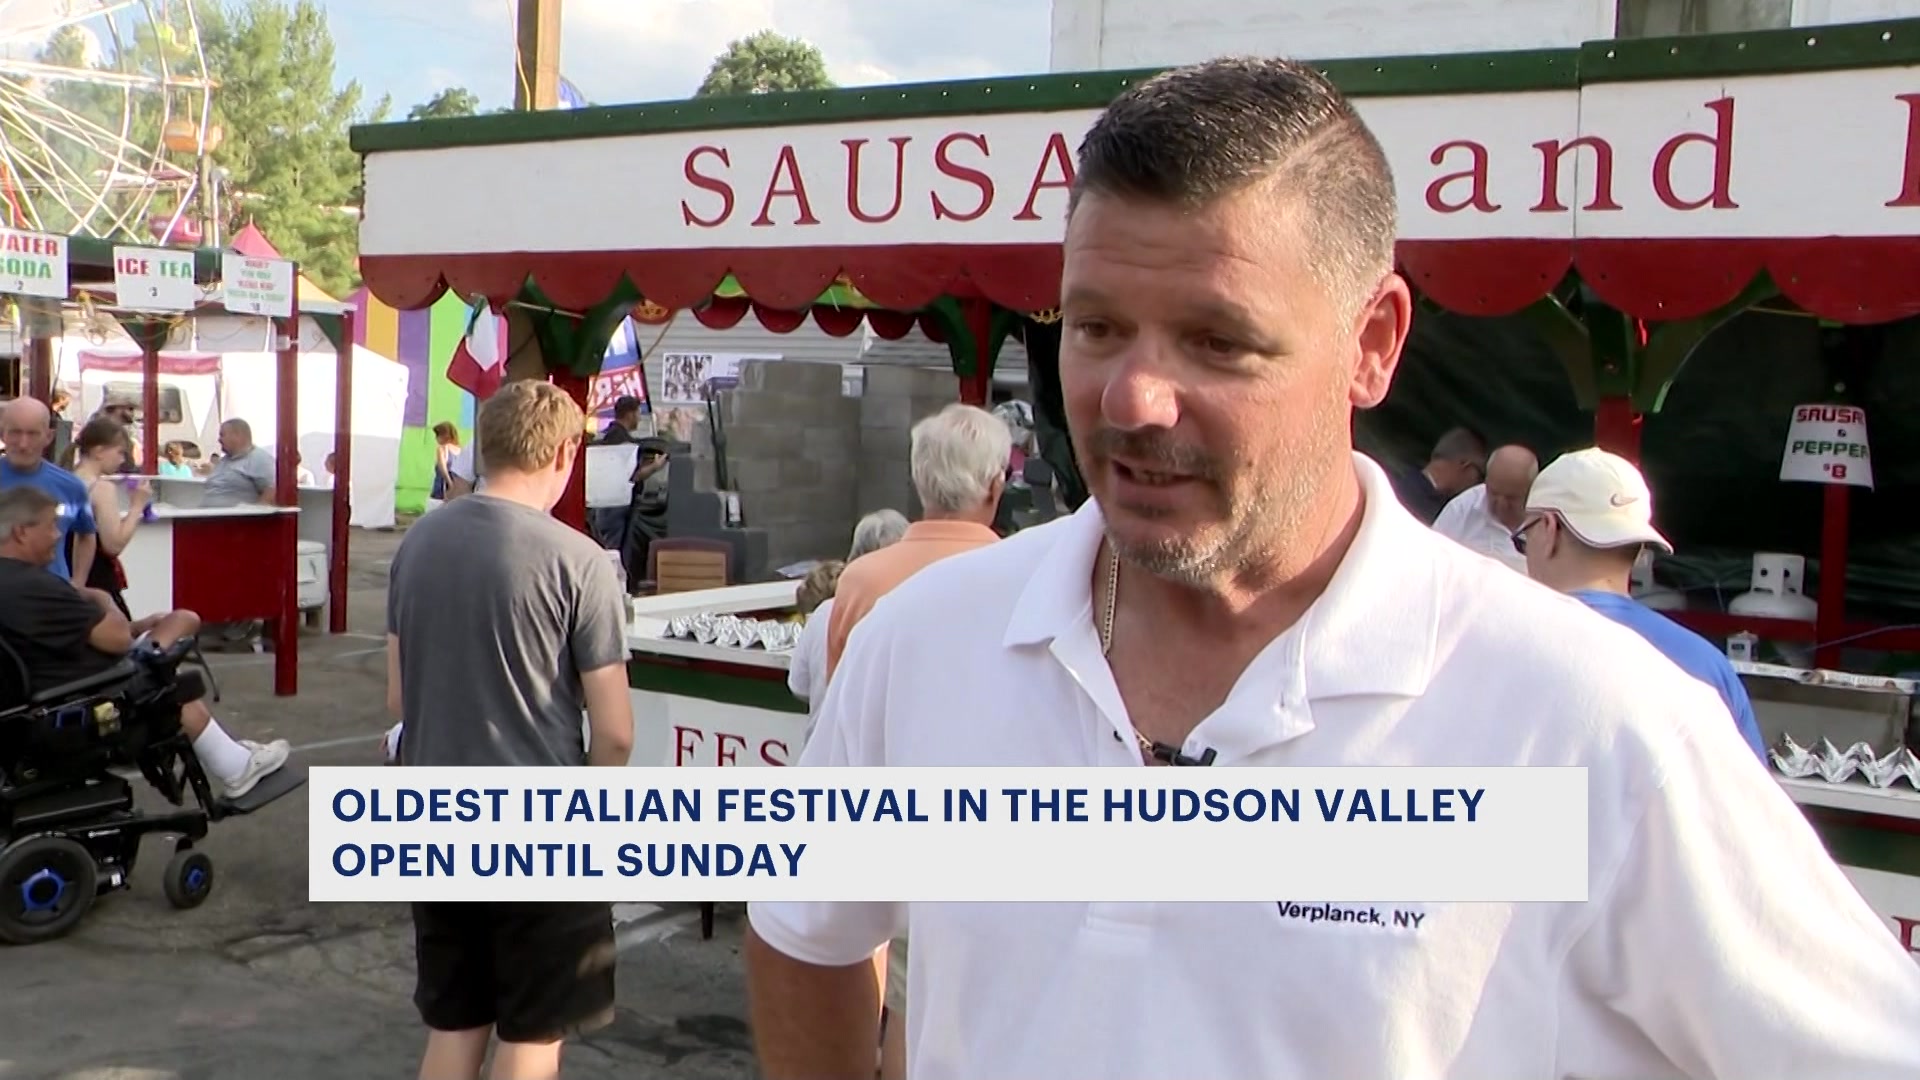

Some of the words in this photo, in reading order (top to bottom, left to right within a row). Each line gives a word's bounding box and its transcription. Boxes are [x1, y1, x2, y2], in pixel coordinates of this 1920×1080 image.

[1424, 96, 1740, 213] and
[117, 258, 149, 276] ICE
[159, 260, 192, 278] TEA
[1276, 901, 1387, 928] Verplanck,
[1393, 909, 1426, 930] NY
